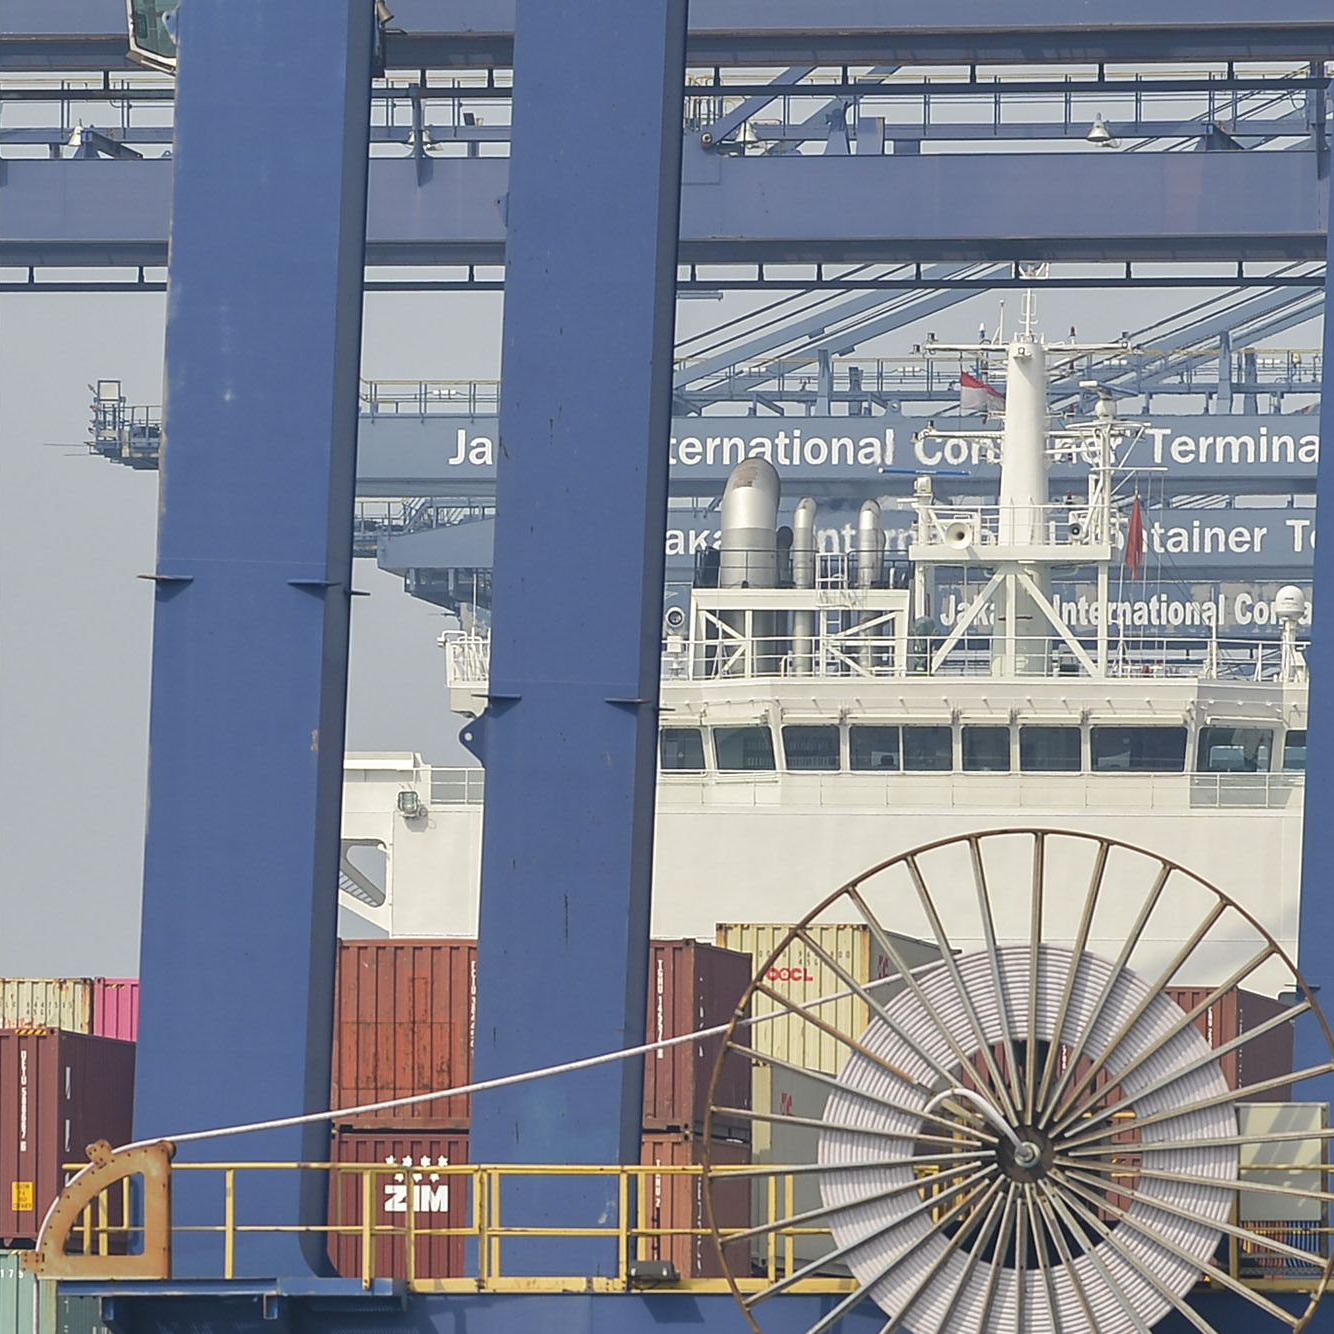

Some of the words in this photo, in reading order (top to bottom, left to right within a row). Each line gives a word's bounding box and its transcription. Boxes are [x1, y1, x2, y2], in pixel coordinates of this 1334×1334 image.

[669, 429, 894, 466] ternational
[1145, 428, 1320, 464] Termina
[767, 967, 813, 981] OOCL
[384, 1185, 448, 1213] ZIM
